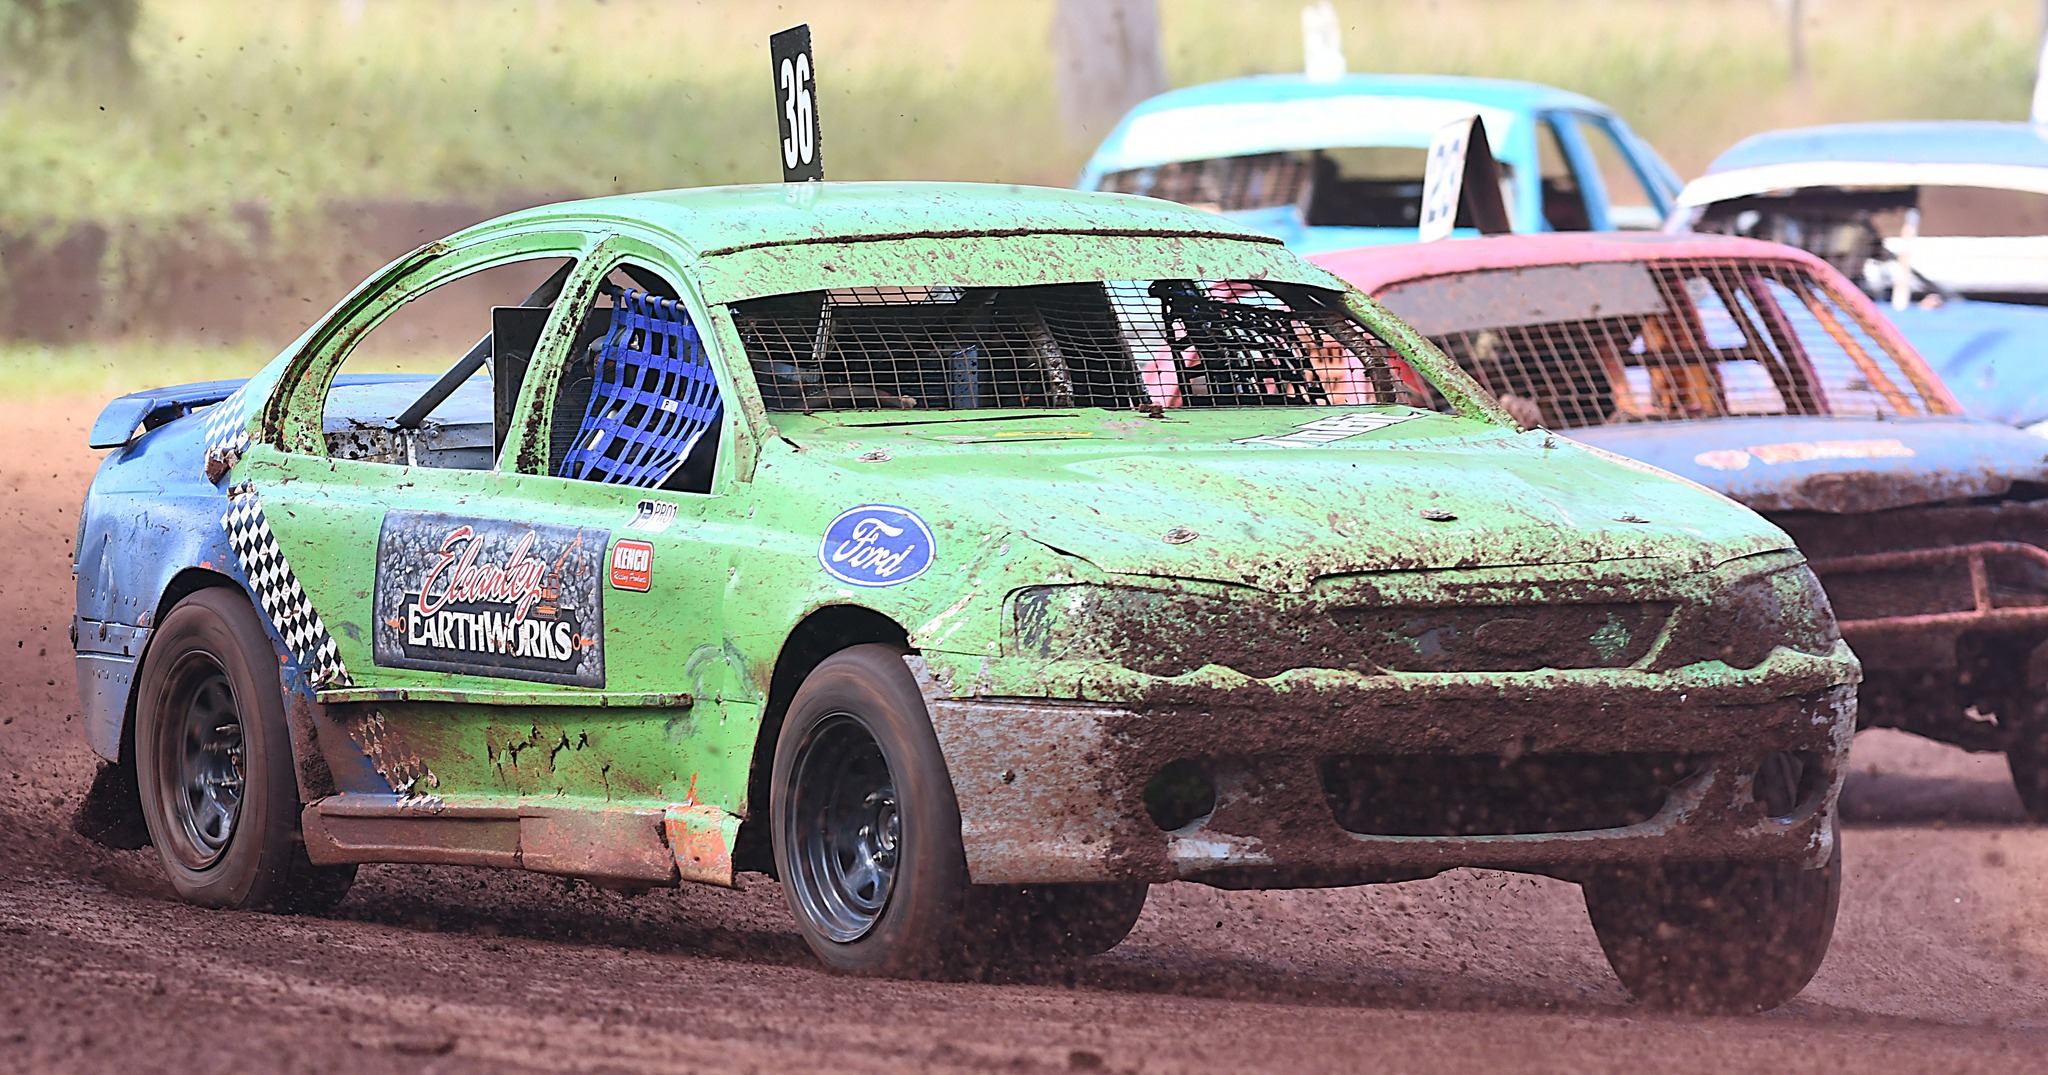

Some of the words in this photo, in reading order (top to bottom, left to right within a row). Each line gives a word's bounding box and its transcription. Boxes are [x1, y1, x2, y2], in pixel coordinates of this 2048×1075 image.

[780, 52, 814, 169] 36
[614, 546, 650, 573] KENCO
[832, 517, 915, 577] Ford
[408, 603, 573, 662] EARTHWORKS
